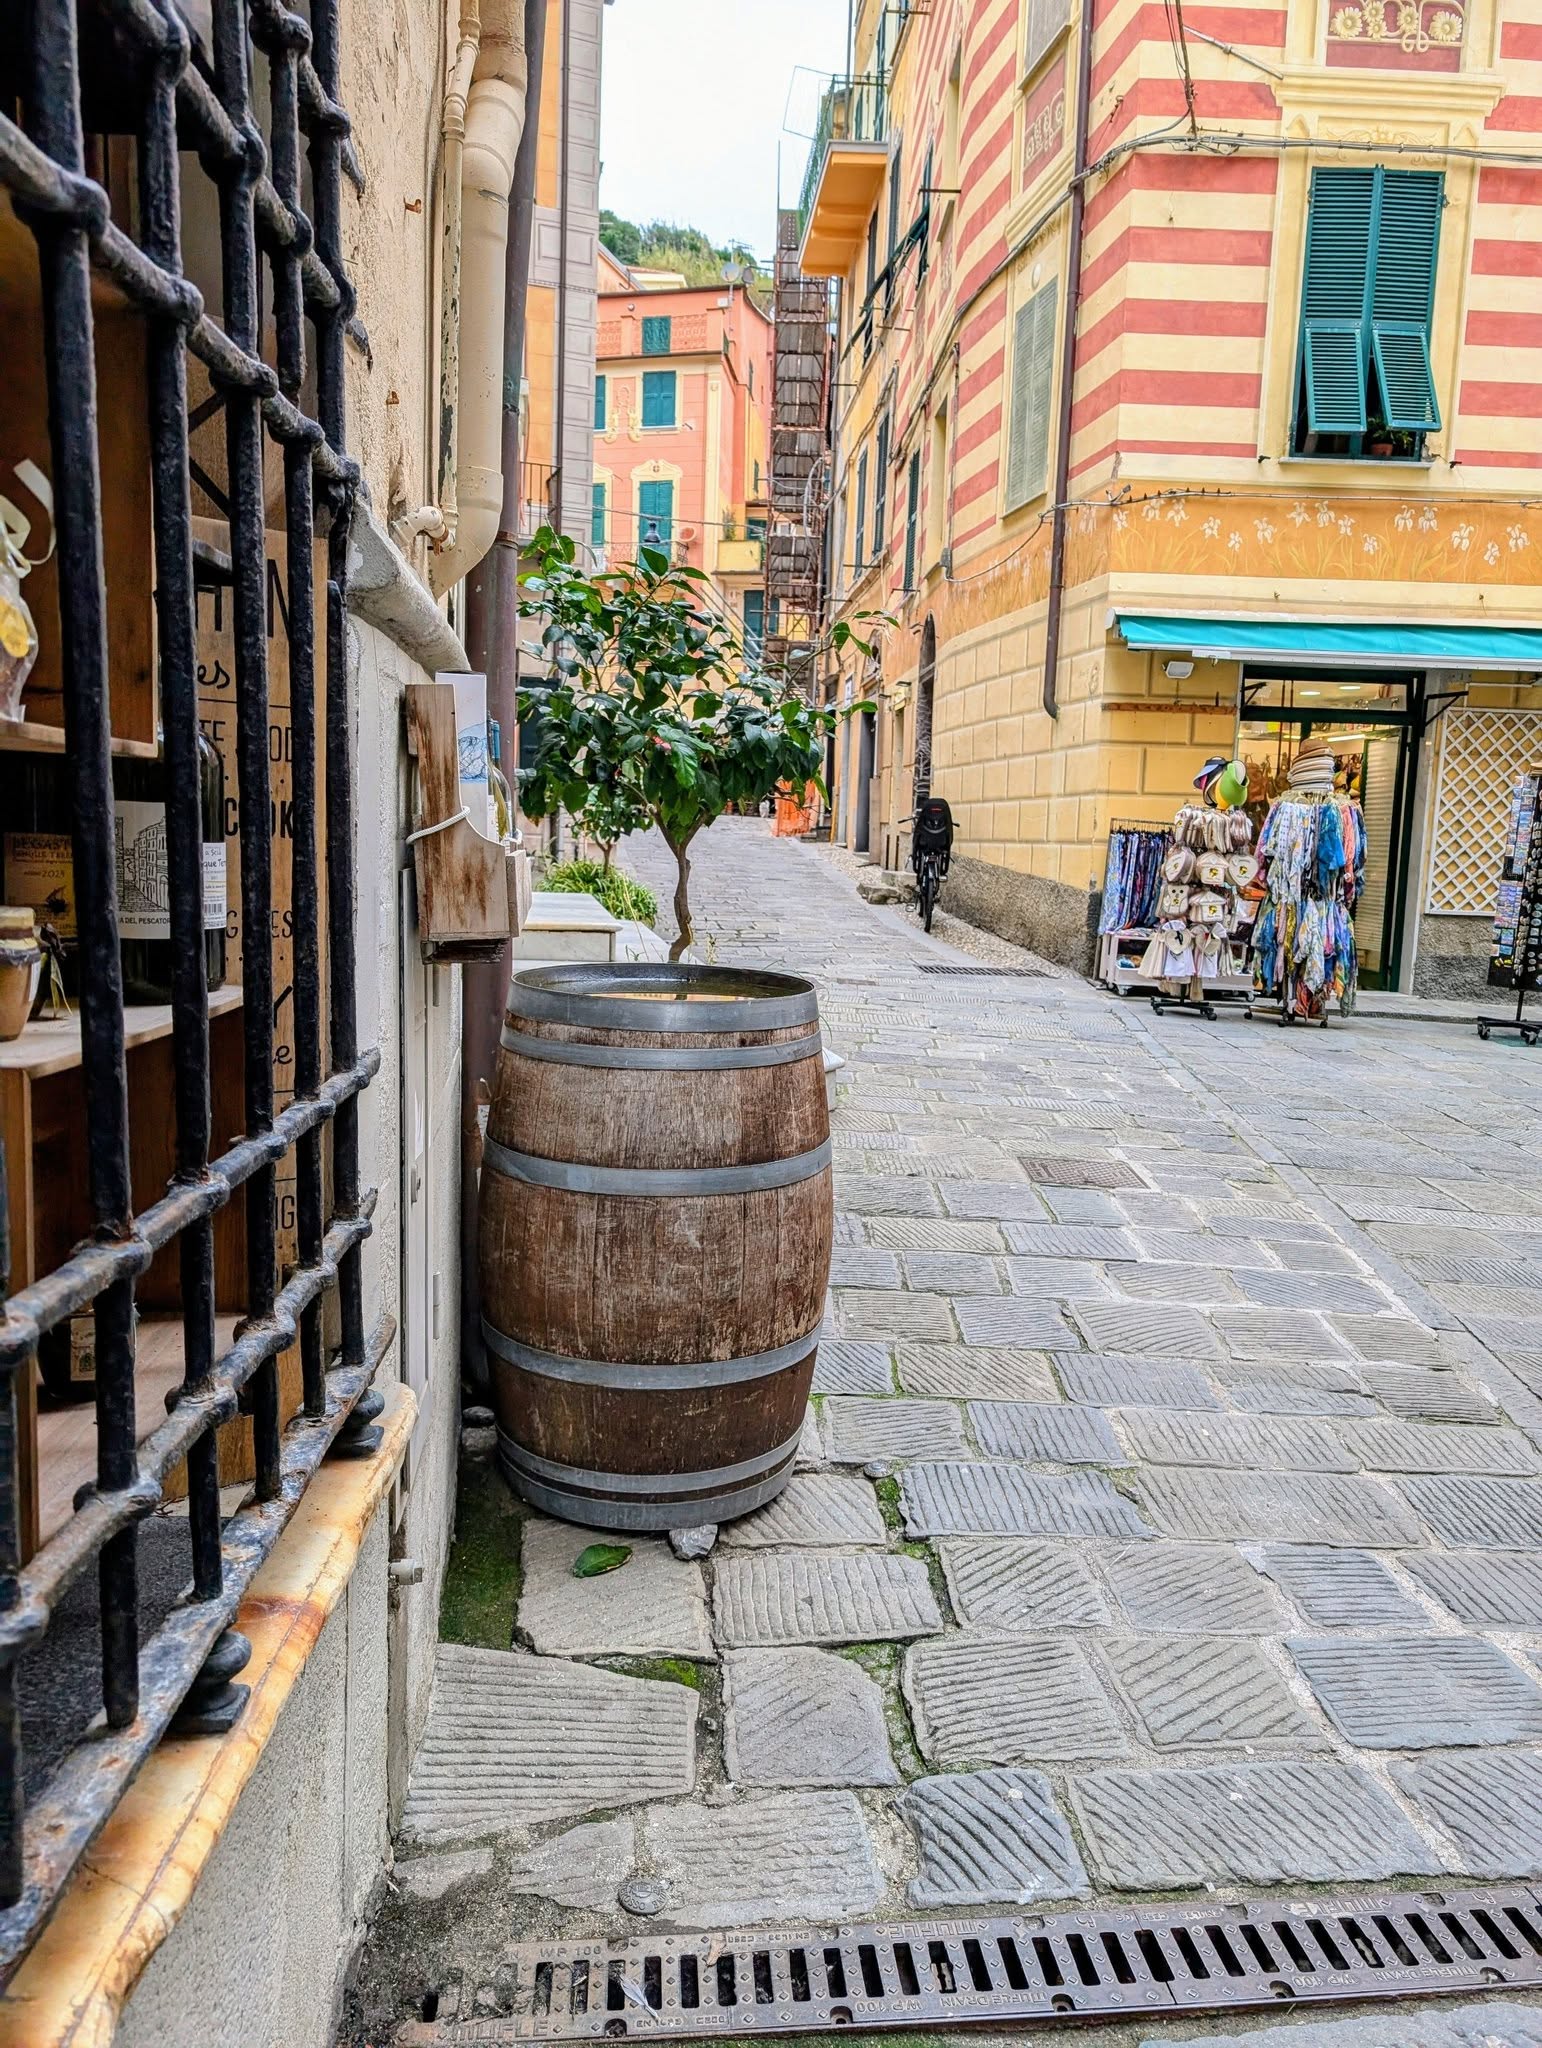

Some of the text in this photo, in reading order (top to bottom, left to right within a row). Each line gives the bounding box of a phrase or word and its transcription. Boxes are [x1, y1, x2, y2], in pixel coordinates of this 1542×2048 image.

[888, 1923, 978, 1939] MUFLE
[855, 1992, 1048, 2013] MUFLE DRAIN WP 100
[451, 2020, 549, 2042] MUFLE
